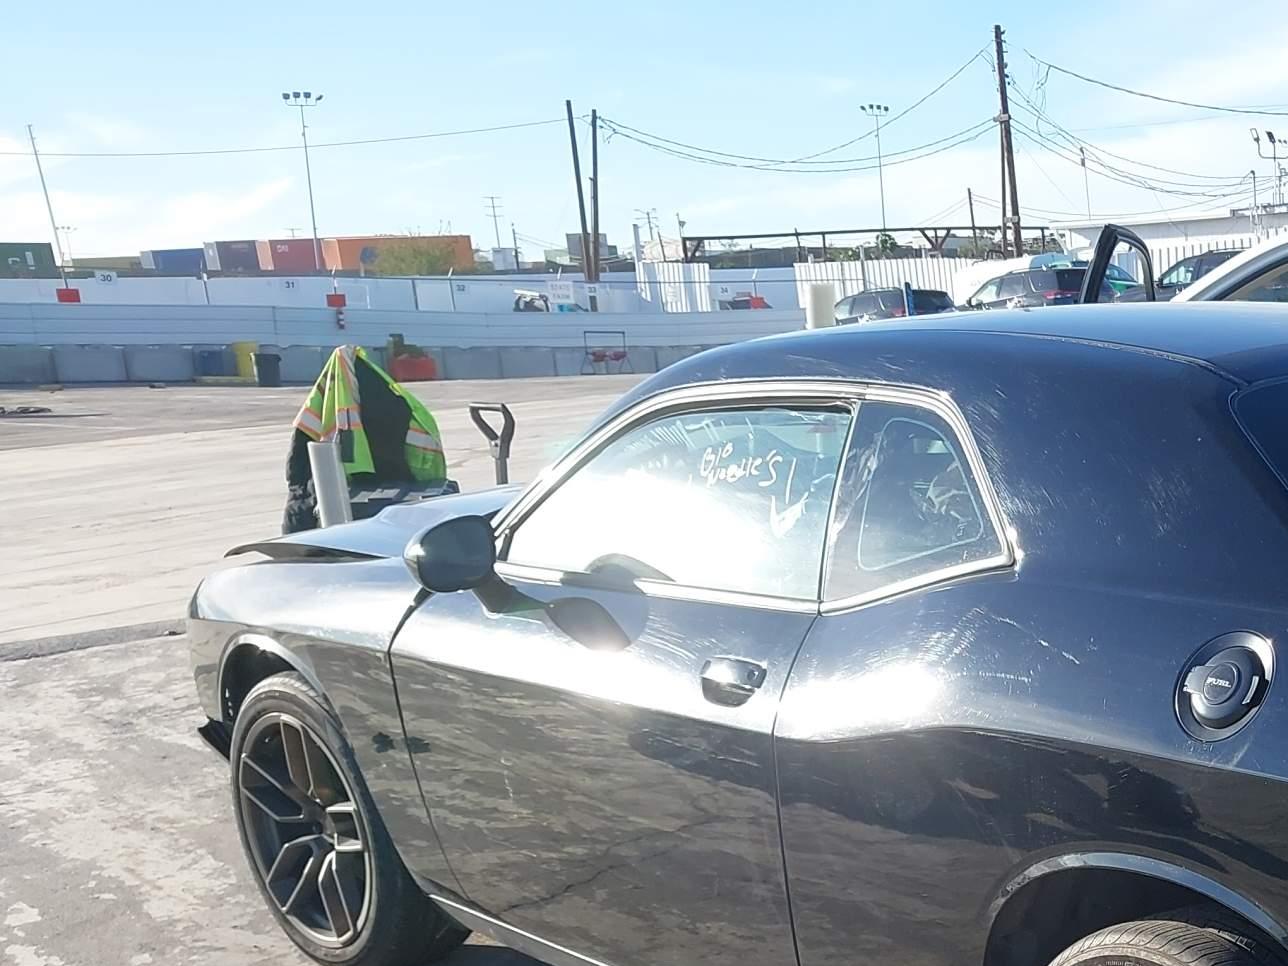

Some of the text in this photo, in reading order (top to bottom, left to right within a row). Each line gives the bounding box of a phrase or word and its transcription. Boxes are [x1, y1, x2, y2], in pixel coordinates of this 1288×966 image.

[100, 274, 112, 282] 30
[285, 281, 295, 289] 31
[720, 286, 729, 294] 34
